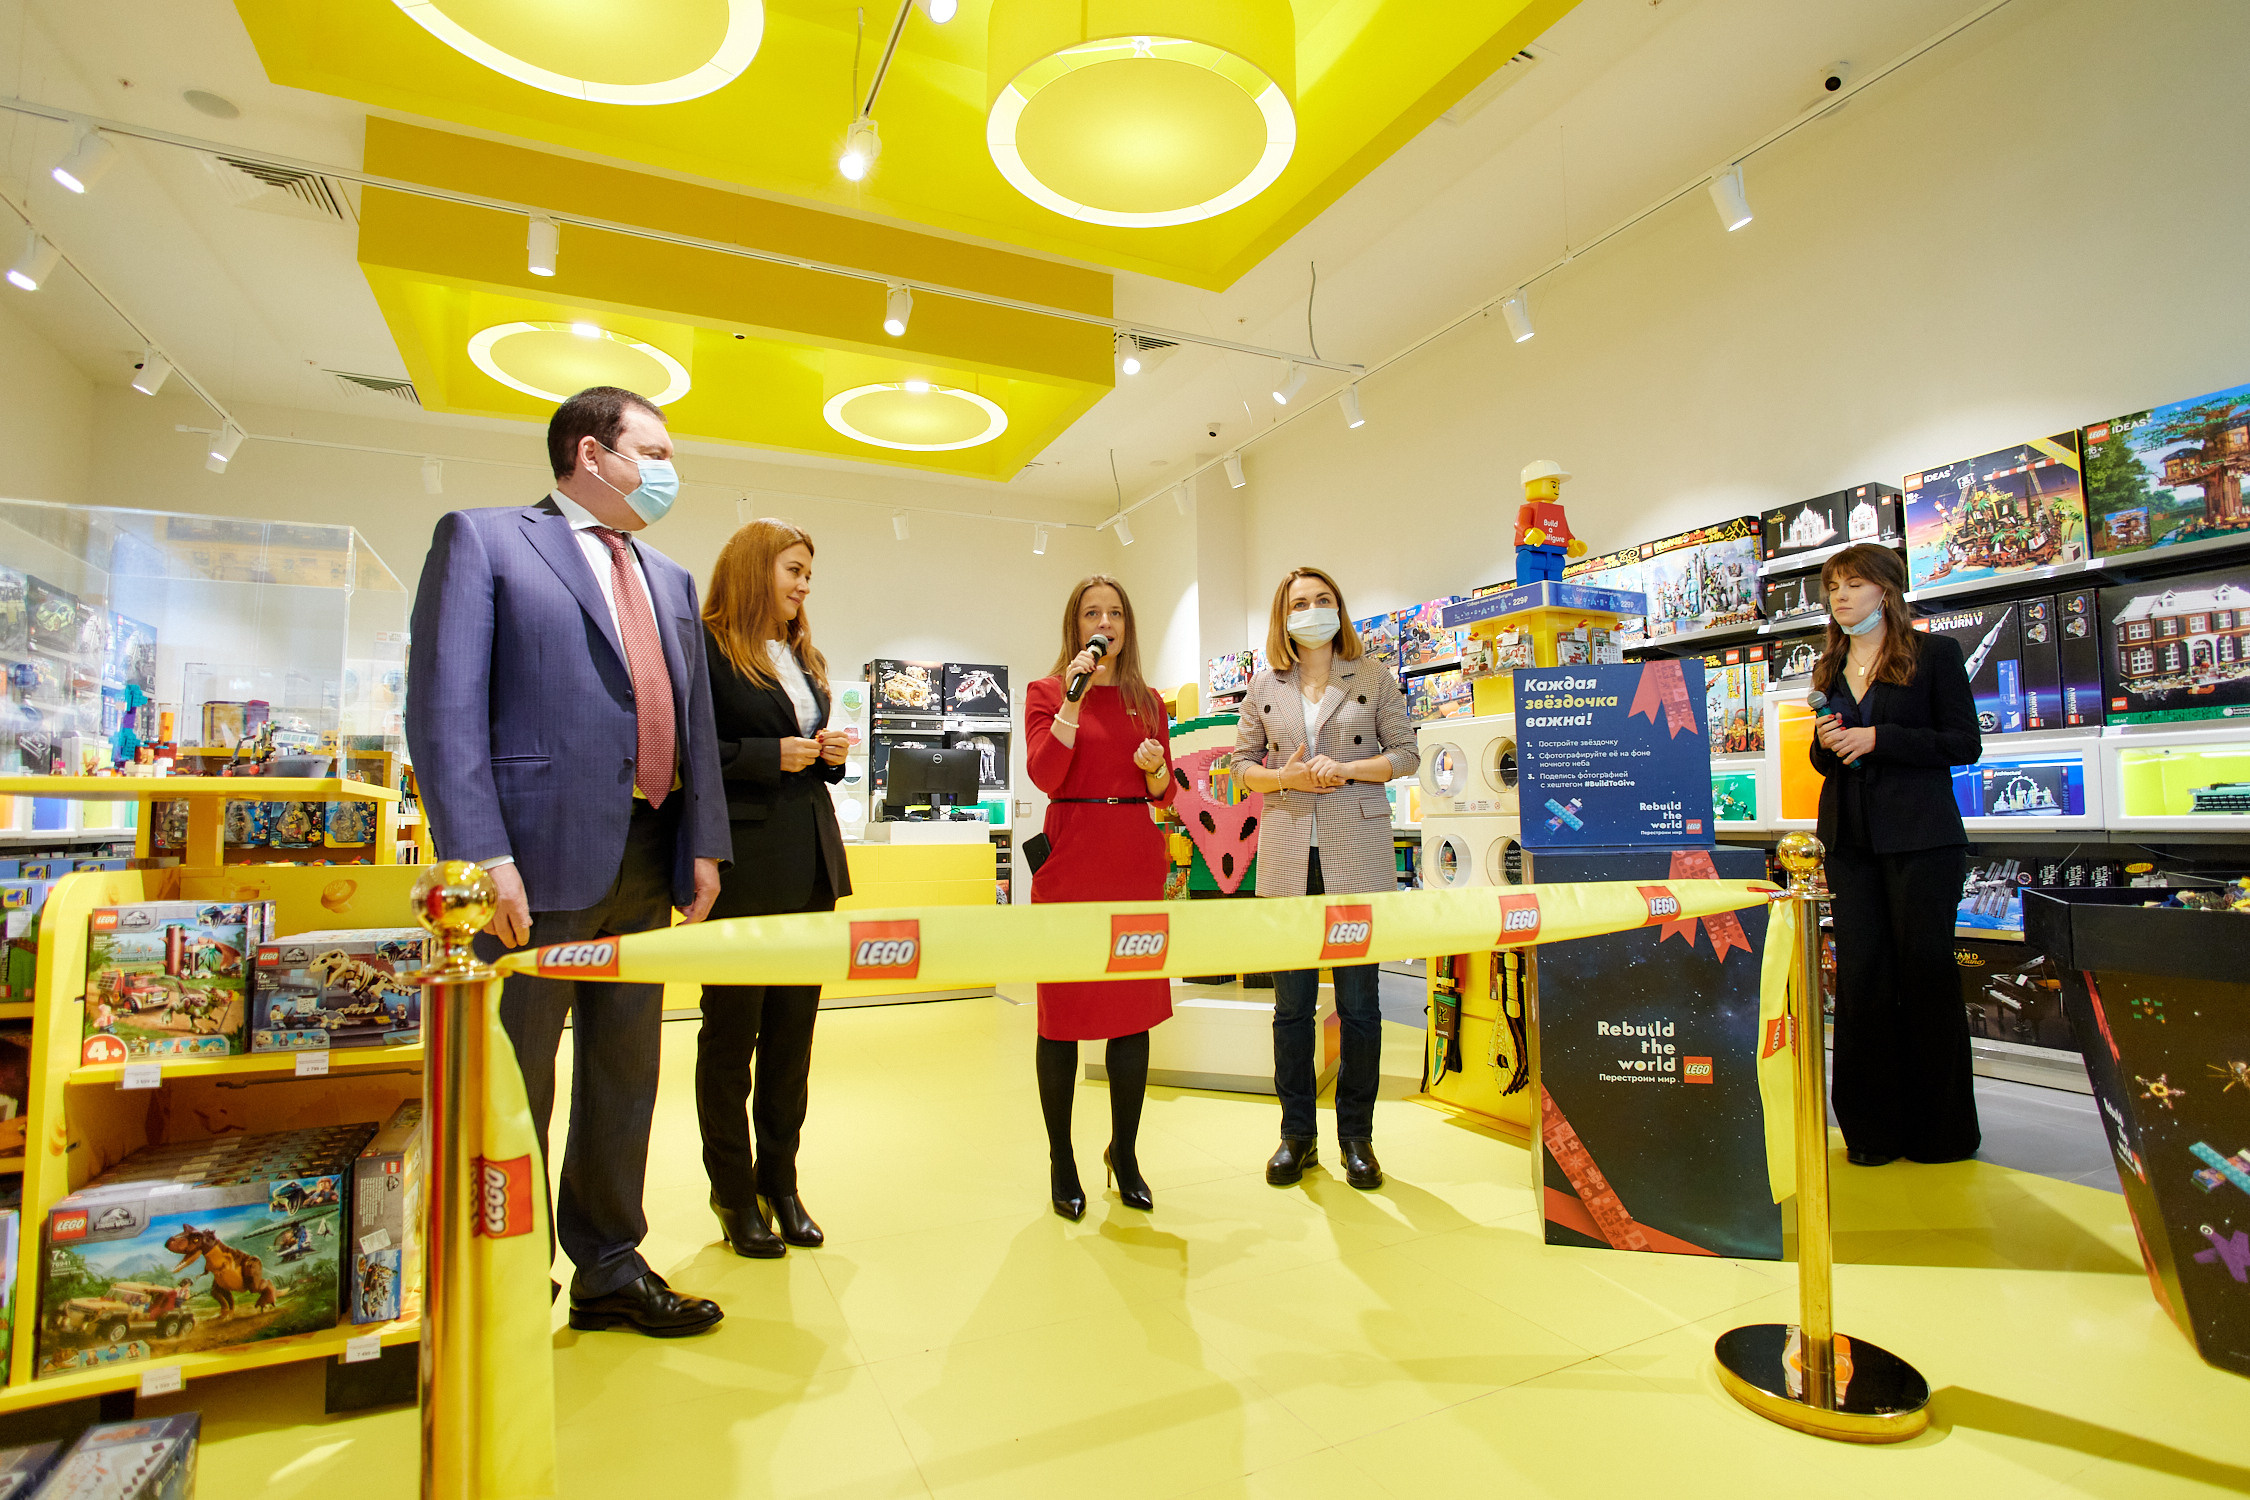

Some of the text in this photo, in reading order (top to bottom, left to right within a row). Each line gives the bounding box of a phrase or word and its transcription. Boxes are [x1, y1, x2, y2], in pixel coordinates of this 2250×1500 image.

[2089, 418, 2147, 439] LEGO IDEAS
[1924, 470, 1951, 483] IDEAS
[1543, 519, 1559, 528] Build
[1953, 611, 1983, 620] APOLLO
[1930, 616, 1983, 632] SATURN V
[1524, 676, 1597, 692] Каждая
[1524, 694, 1618, 710] звёздочка
[1525, 712, 1593, 728] важна!
[1580, 738, 1619, 746] звёздочку
[1538, 750, 1607, 760] Сфотографируйте
[1630, 748, 1651, 757] фоне
[1572, 759, 1590, 767] неба
[1539, 772, 1576, 781] Поделись
[1577, 770, 1629, 780] фотографией
[1584, 779, 1636, 788] #BuildToGive
[1639, 801, 1682, 811] Rebuild
[1662, 811, 1682, 820] the
[1650, 820, 1683, 829] world
[1650, 897, 1678, 916] LEGO
[96, 915, 117, 925] LEGO
[1504, 910, 1539, 931] LEGO
[1328, 922, 1369, 944] LEGO
[1115, 933, 1165, 957] LEGO
[543, 943, 614, 967] LEGO
[855, 940, 915, 966] LEGO
[1598, 1021, 1675, 1037] Rebuild
[87, 1041, 122, 1061] 4+
[1641, 1038, 1676, 1055] the
[1618, 1056, 1676, 1072] world
[1685, 1064, 1711, 1075] LEGO
[1599, 1073, 1676, 1084] Перестроим мир
[56, 1218, 86, 1231] LEGO
[52, 1249, 68, 1260] 7+
